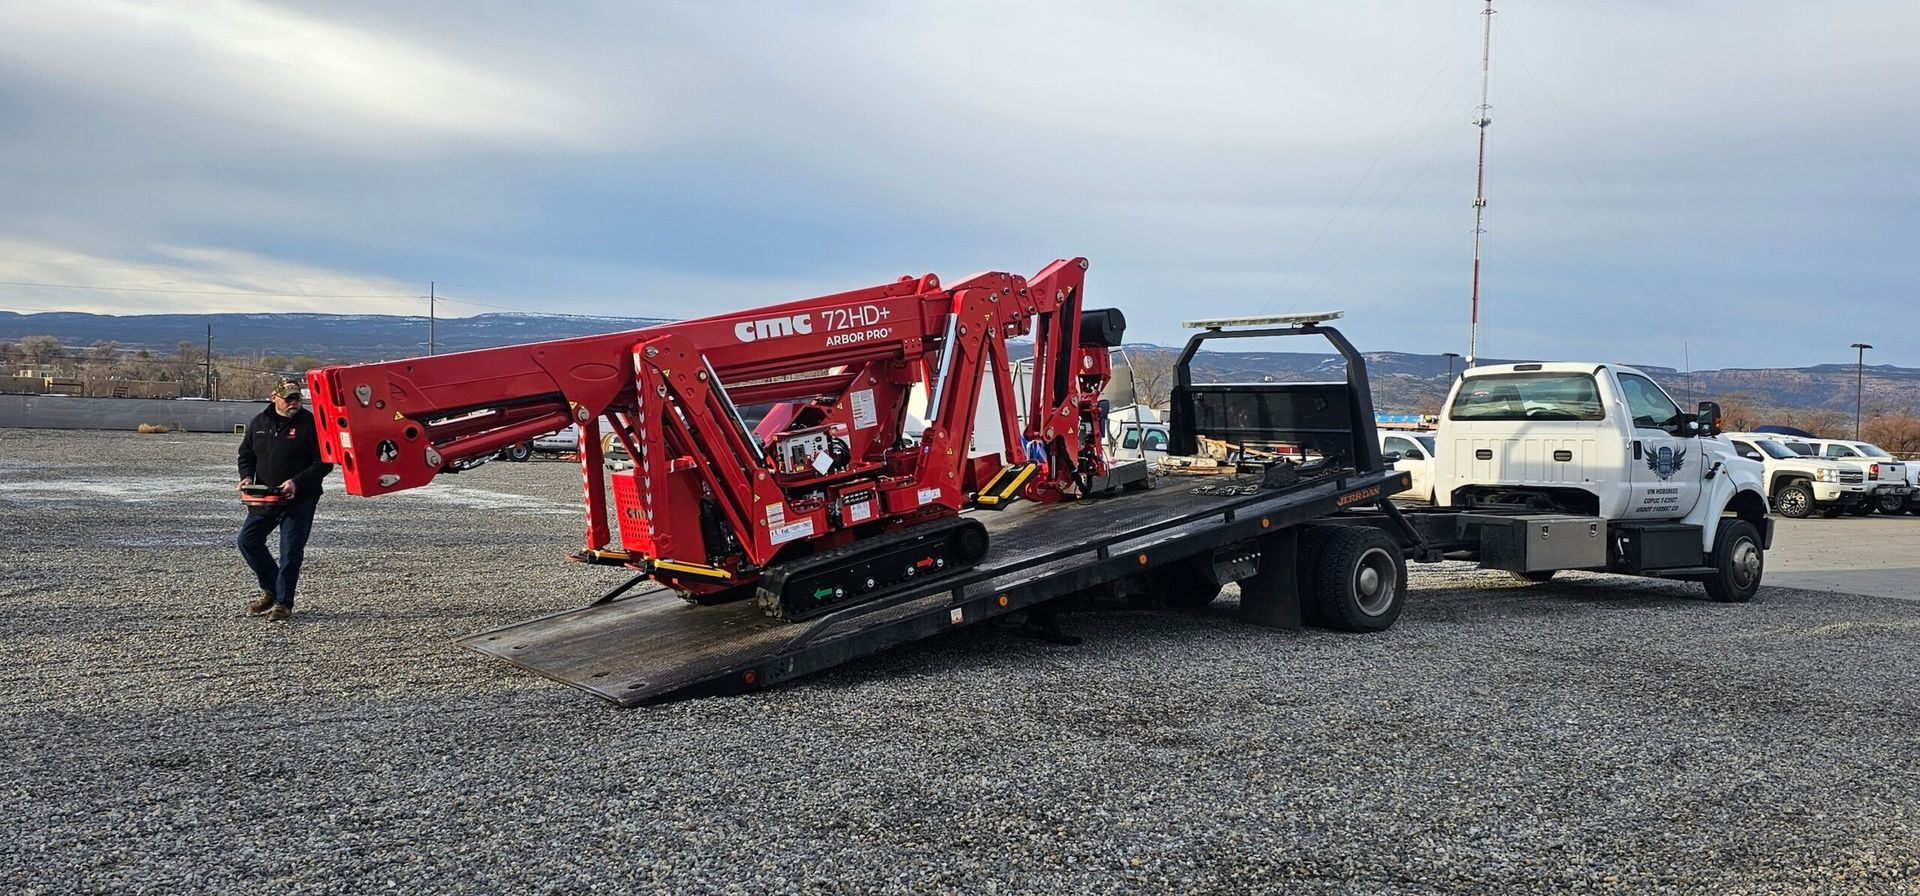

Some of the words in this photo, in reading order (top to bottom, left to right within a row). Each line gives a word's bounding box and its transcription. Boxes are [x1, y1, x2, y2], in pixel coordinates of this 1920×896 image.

[734, 313, 813, 343] cmc
[821, 305, 891, 331] 72HD+
[825, 332, 864, 347] ARBOR
